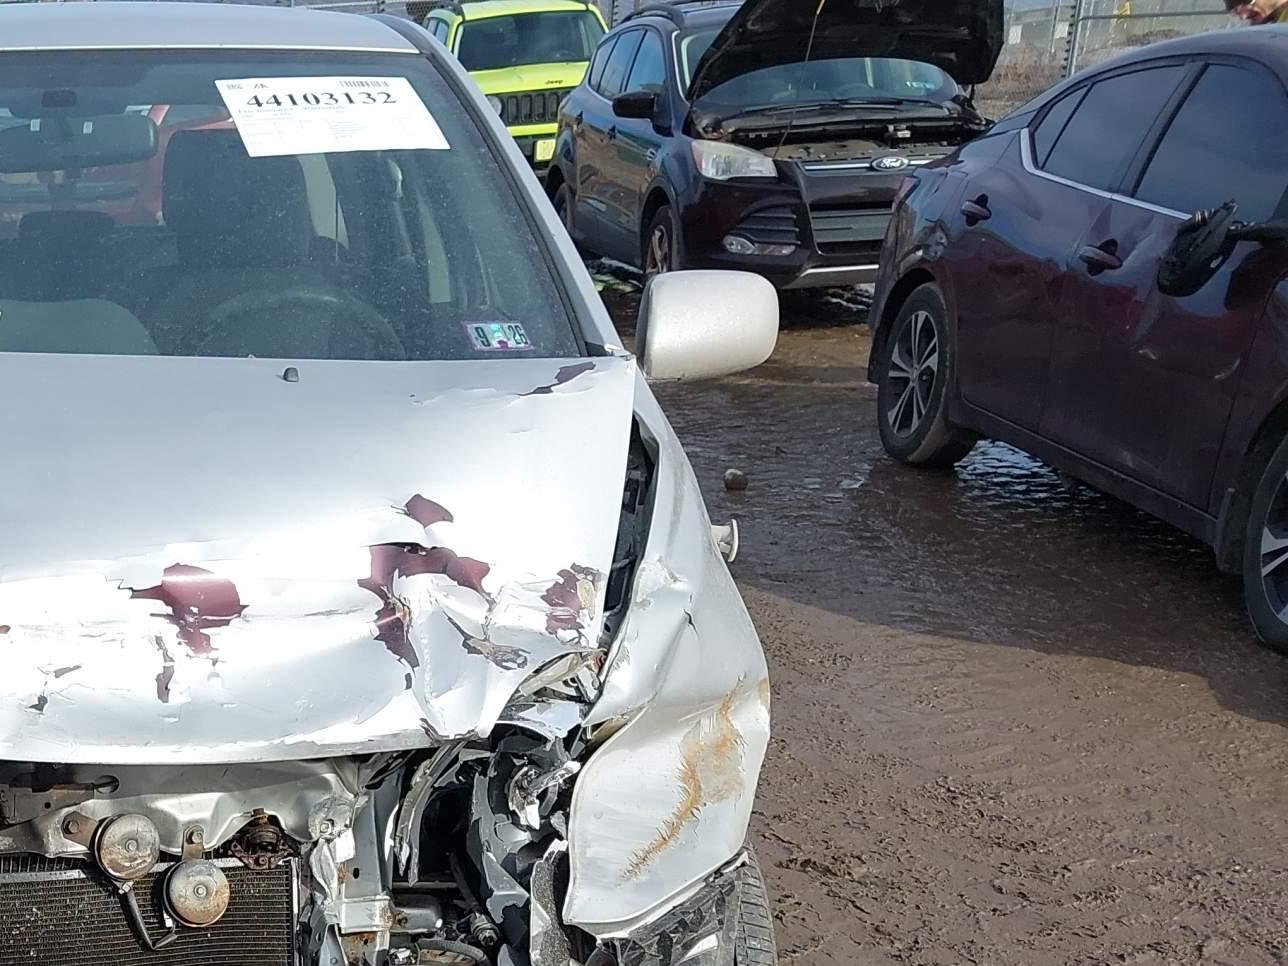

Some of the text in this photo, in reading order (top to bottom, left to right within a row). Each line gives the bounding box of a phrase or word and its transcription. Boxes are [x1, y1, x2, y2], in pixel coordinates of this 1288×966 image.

[246, 91, 397, 108] 44103132
[880, 158, 902, 168] Ford
[474, 324, 529, 347] 9 26
